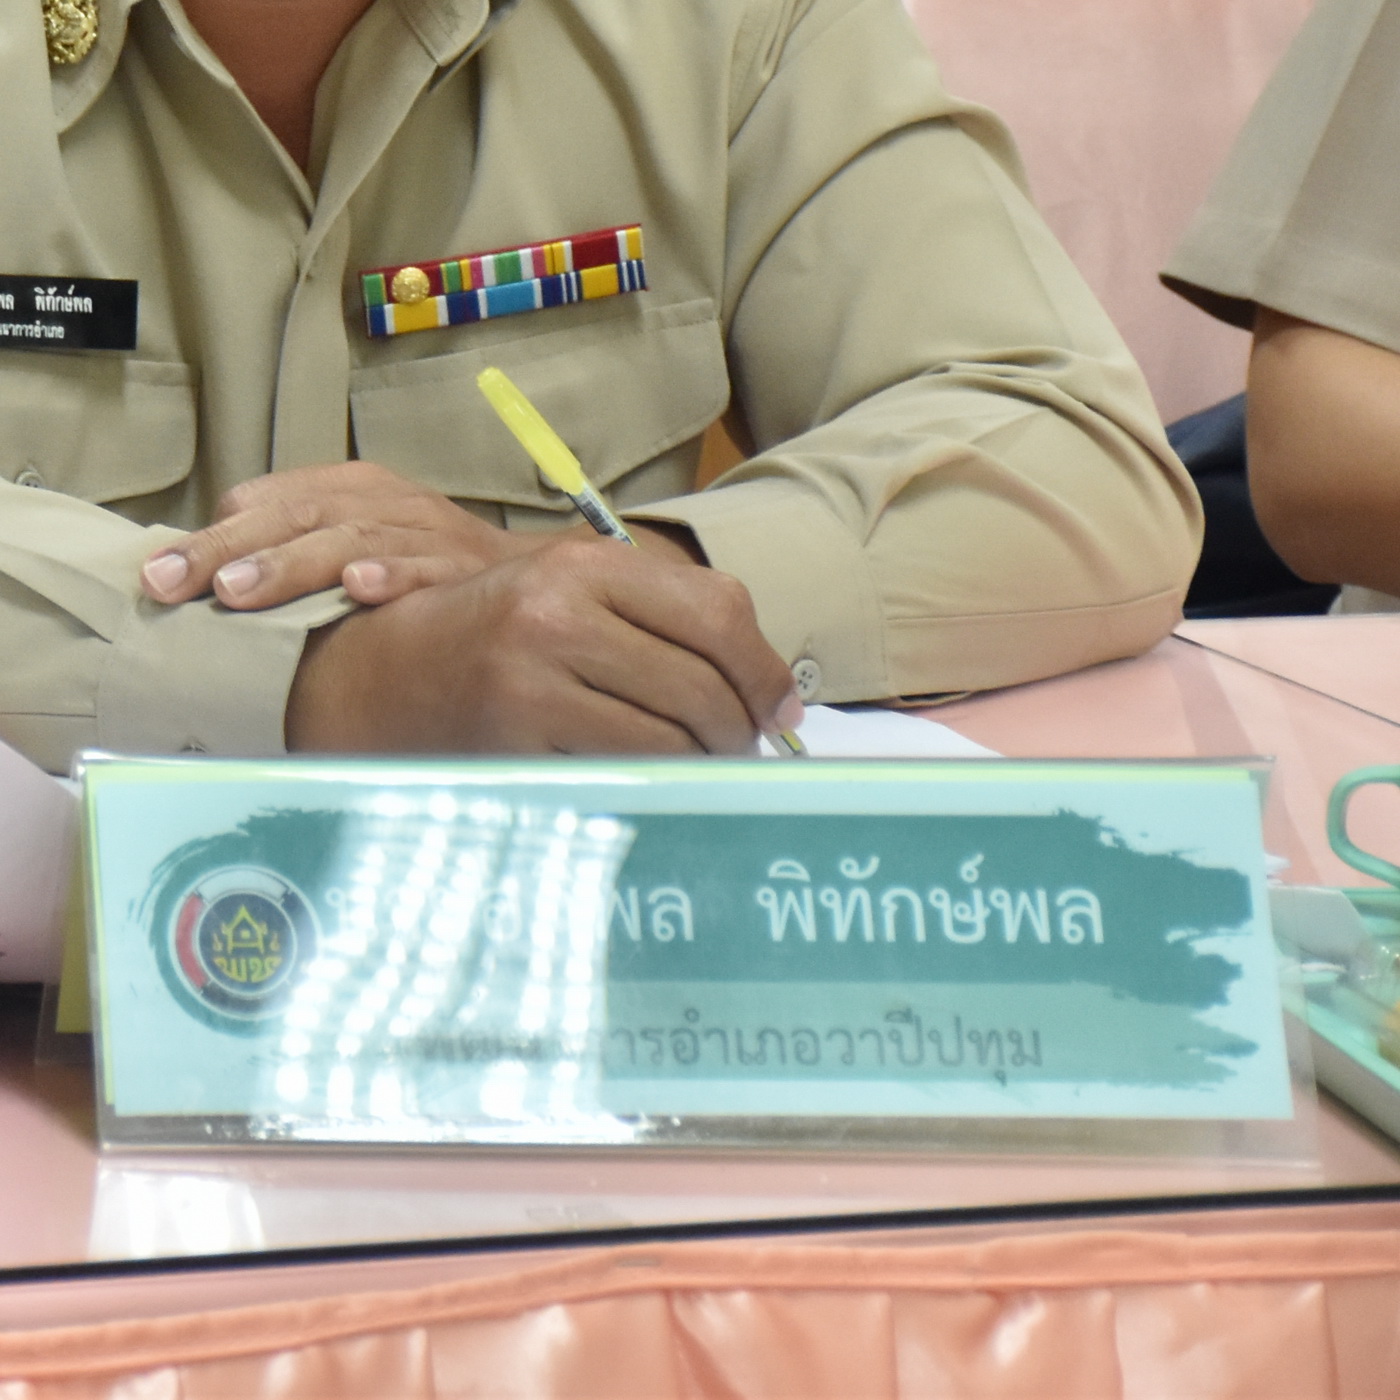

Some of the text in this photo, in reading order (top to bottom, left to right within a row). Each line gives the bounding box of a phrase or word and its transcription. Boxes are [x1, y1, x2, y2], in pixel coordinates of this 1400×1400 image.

[33, 284, 93, 313] พิทักษ์พล
[756, 853, 1105, 944] พิทักษ์พล
